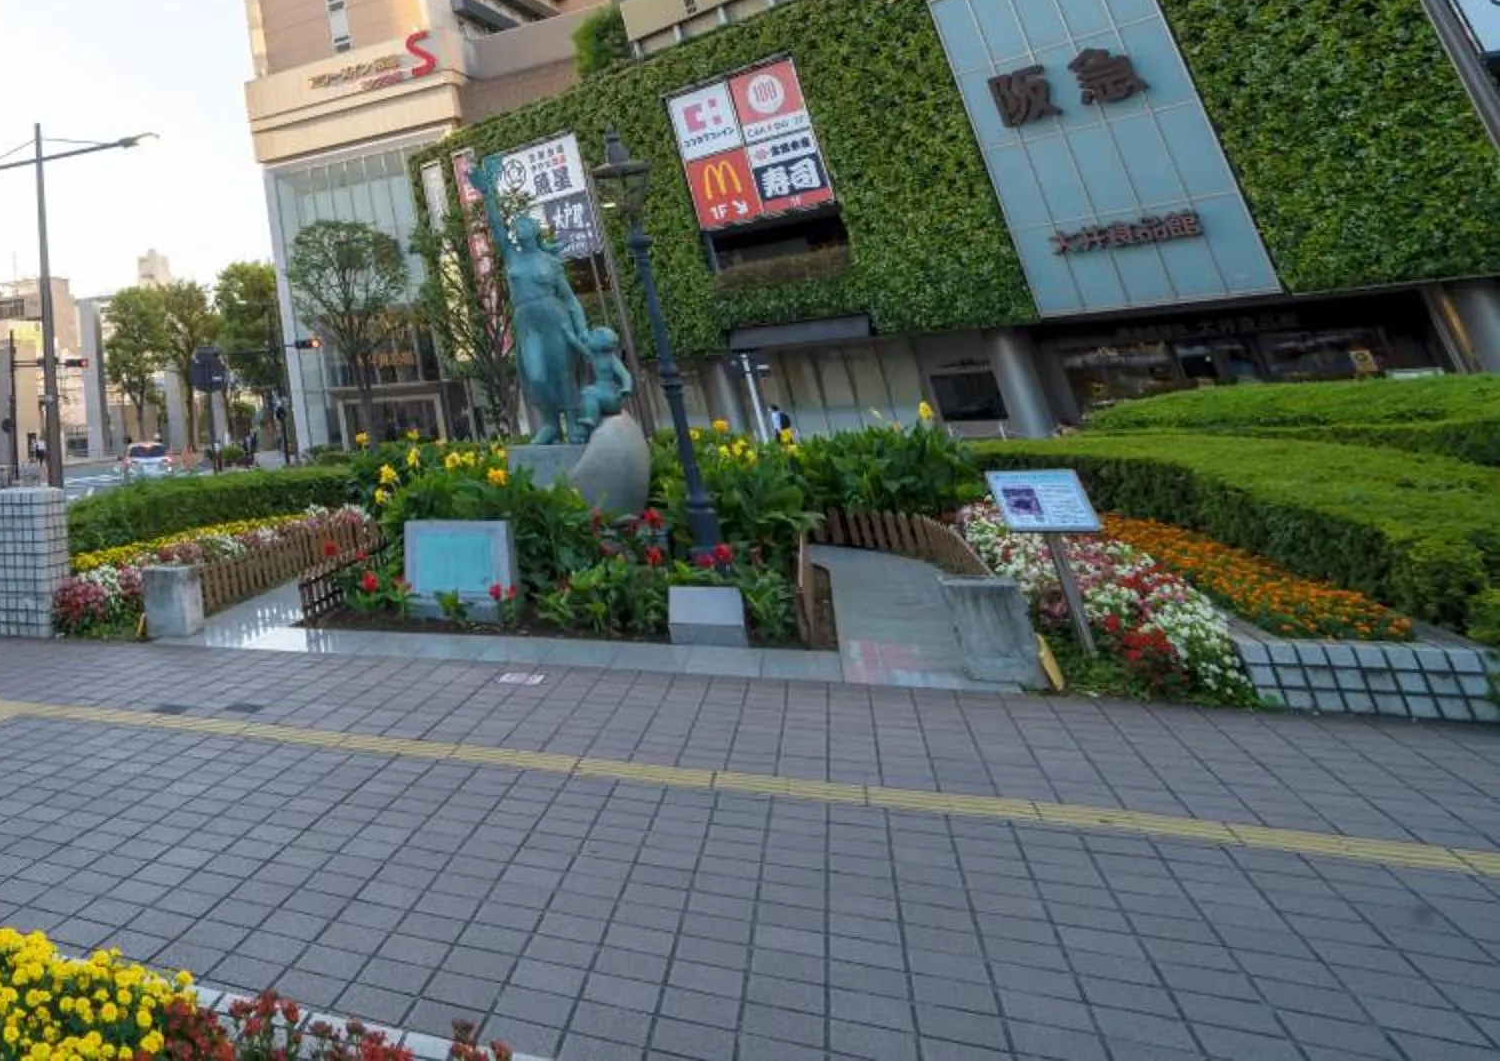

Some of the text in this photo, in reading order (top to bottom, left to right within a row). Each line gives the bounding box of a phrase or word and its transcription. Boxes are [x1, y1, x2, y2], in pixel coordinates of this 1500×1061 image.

[405, 29, 437, 77] S
[987, 47, 1150, 129] 阪急
[760, 157, 822, 198] 寿司
[709, 203, 729, 220] 1F
